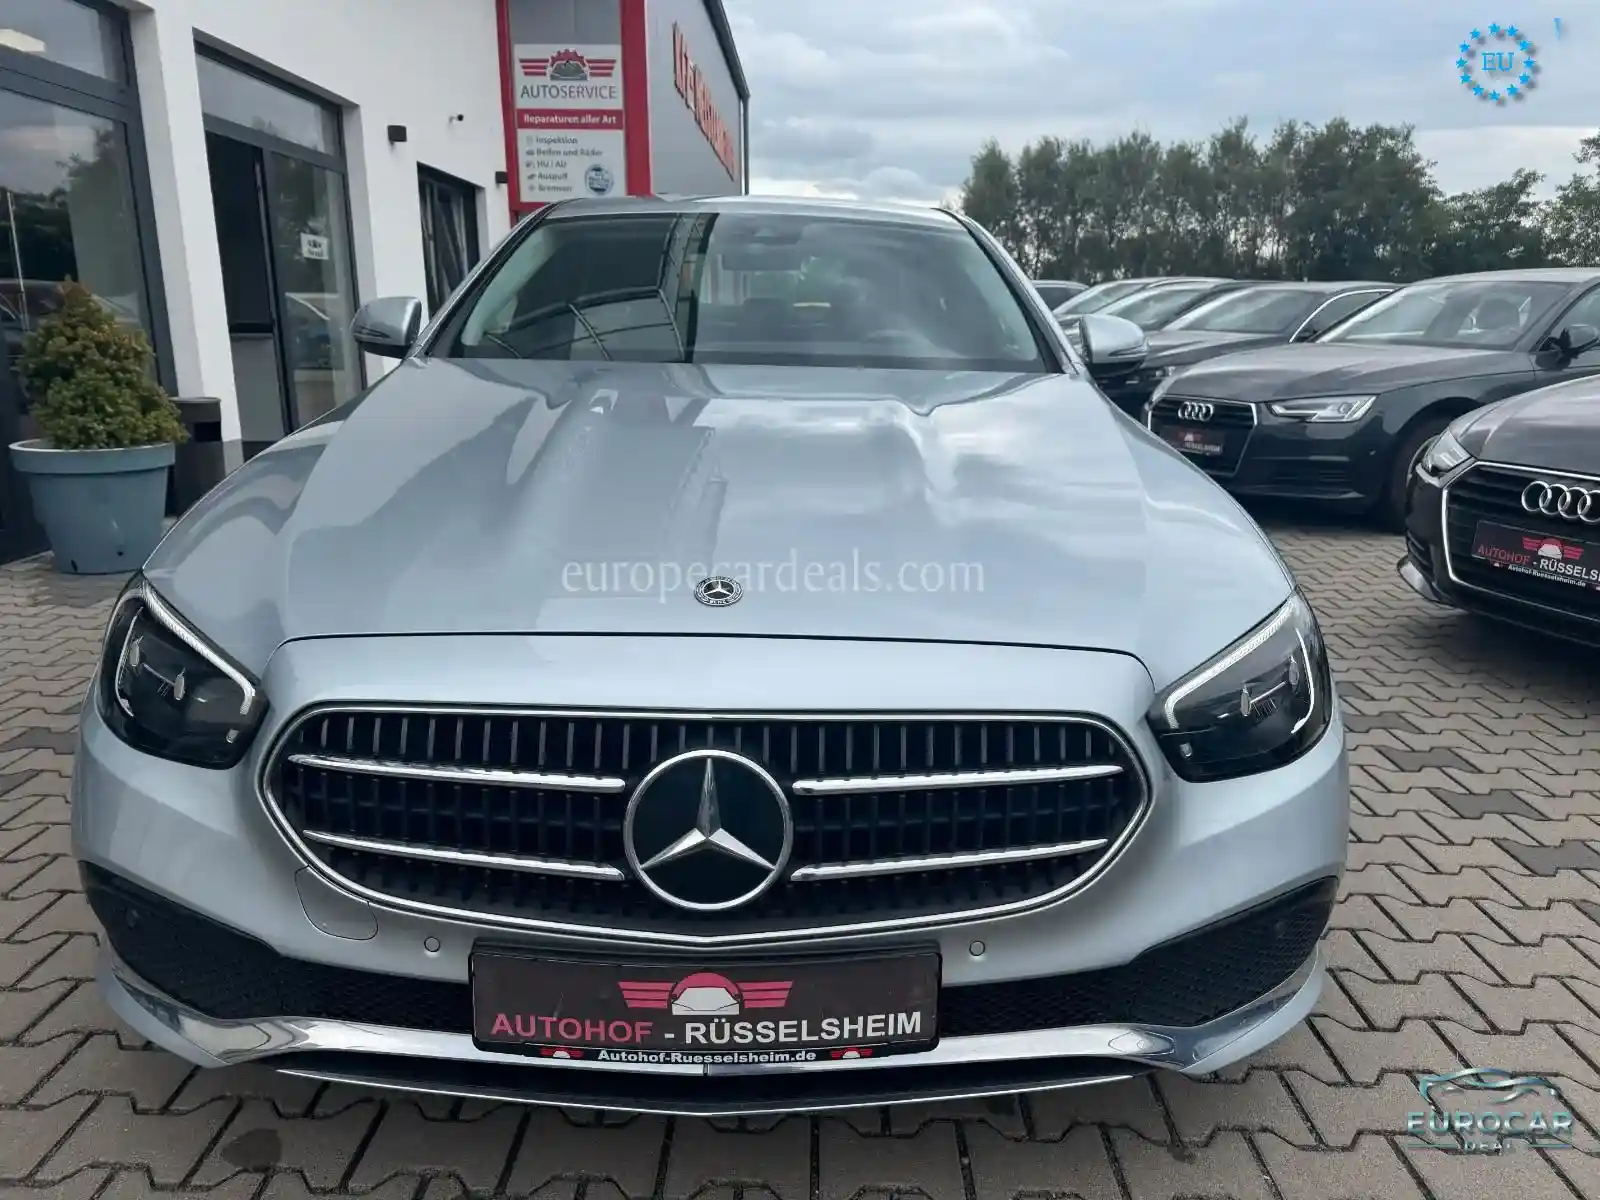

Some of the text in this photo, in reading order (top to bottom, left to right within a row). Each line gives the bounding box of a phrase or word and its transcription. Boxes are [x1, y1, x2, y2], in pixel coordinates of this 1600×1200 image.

[520, 84, 617, 99] AUTOSERVICE
[523, 113, 617, 126] Reparaturen aller Art
[536, 136, 578, 145] Inspektion
[1478, 543, 1530, 565] AUTOHOF
[1540, 558, 1600, 583] RÜSSELS
[491, 1013, 653, 1044] AUTOHOF
[685, 1011, 921, 1044] RÜSSELSHEIM
[597, 1049, 817, 1063] Autohof-Ruesselsheim.de
